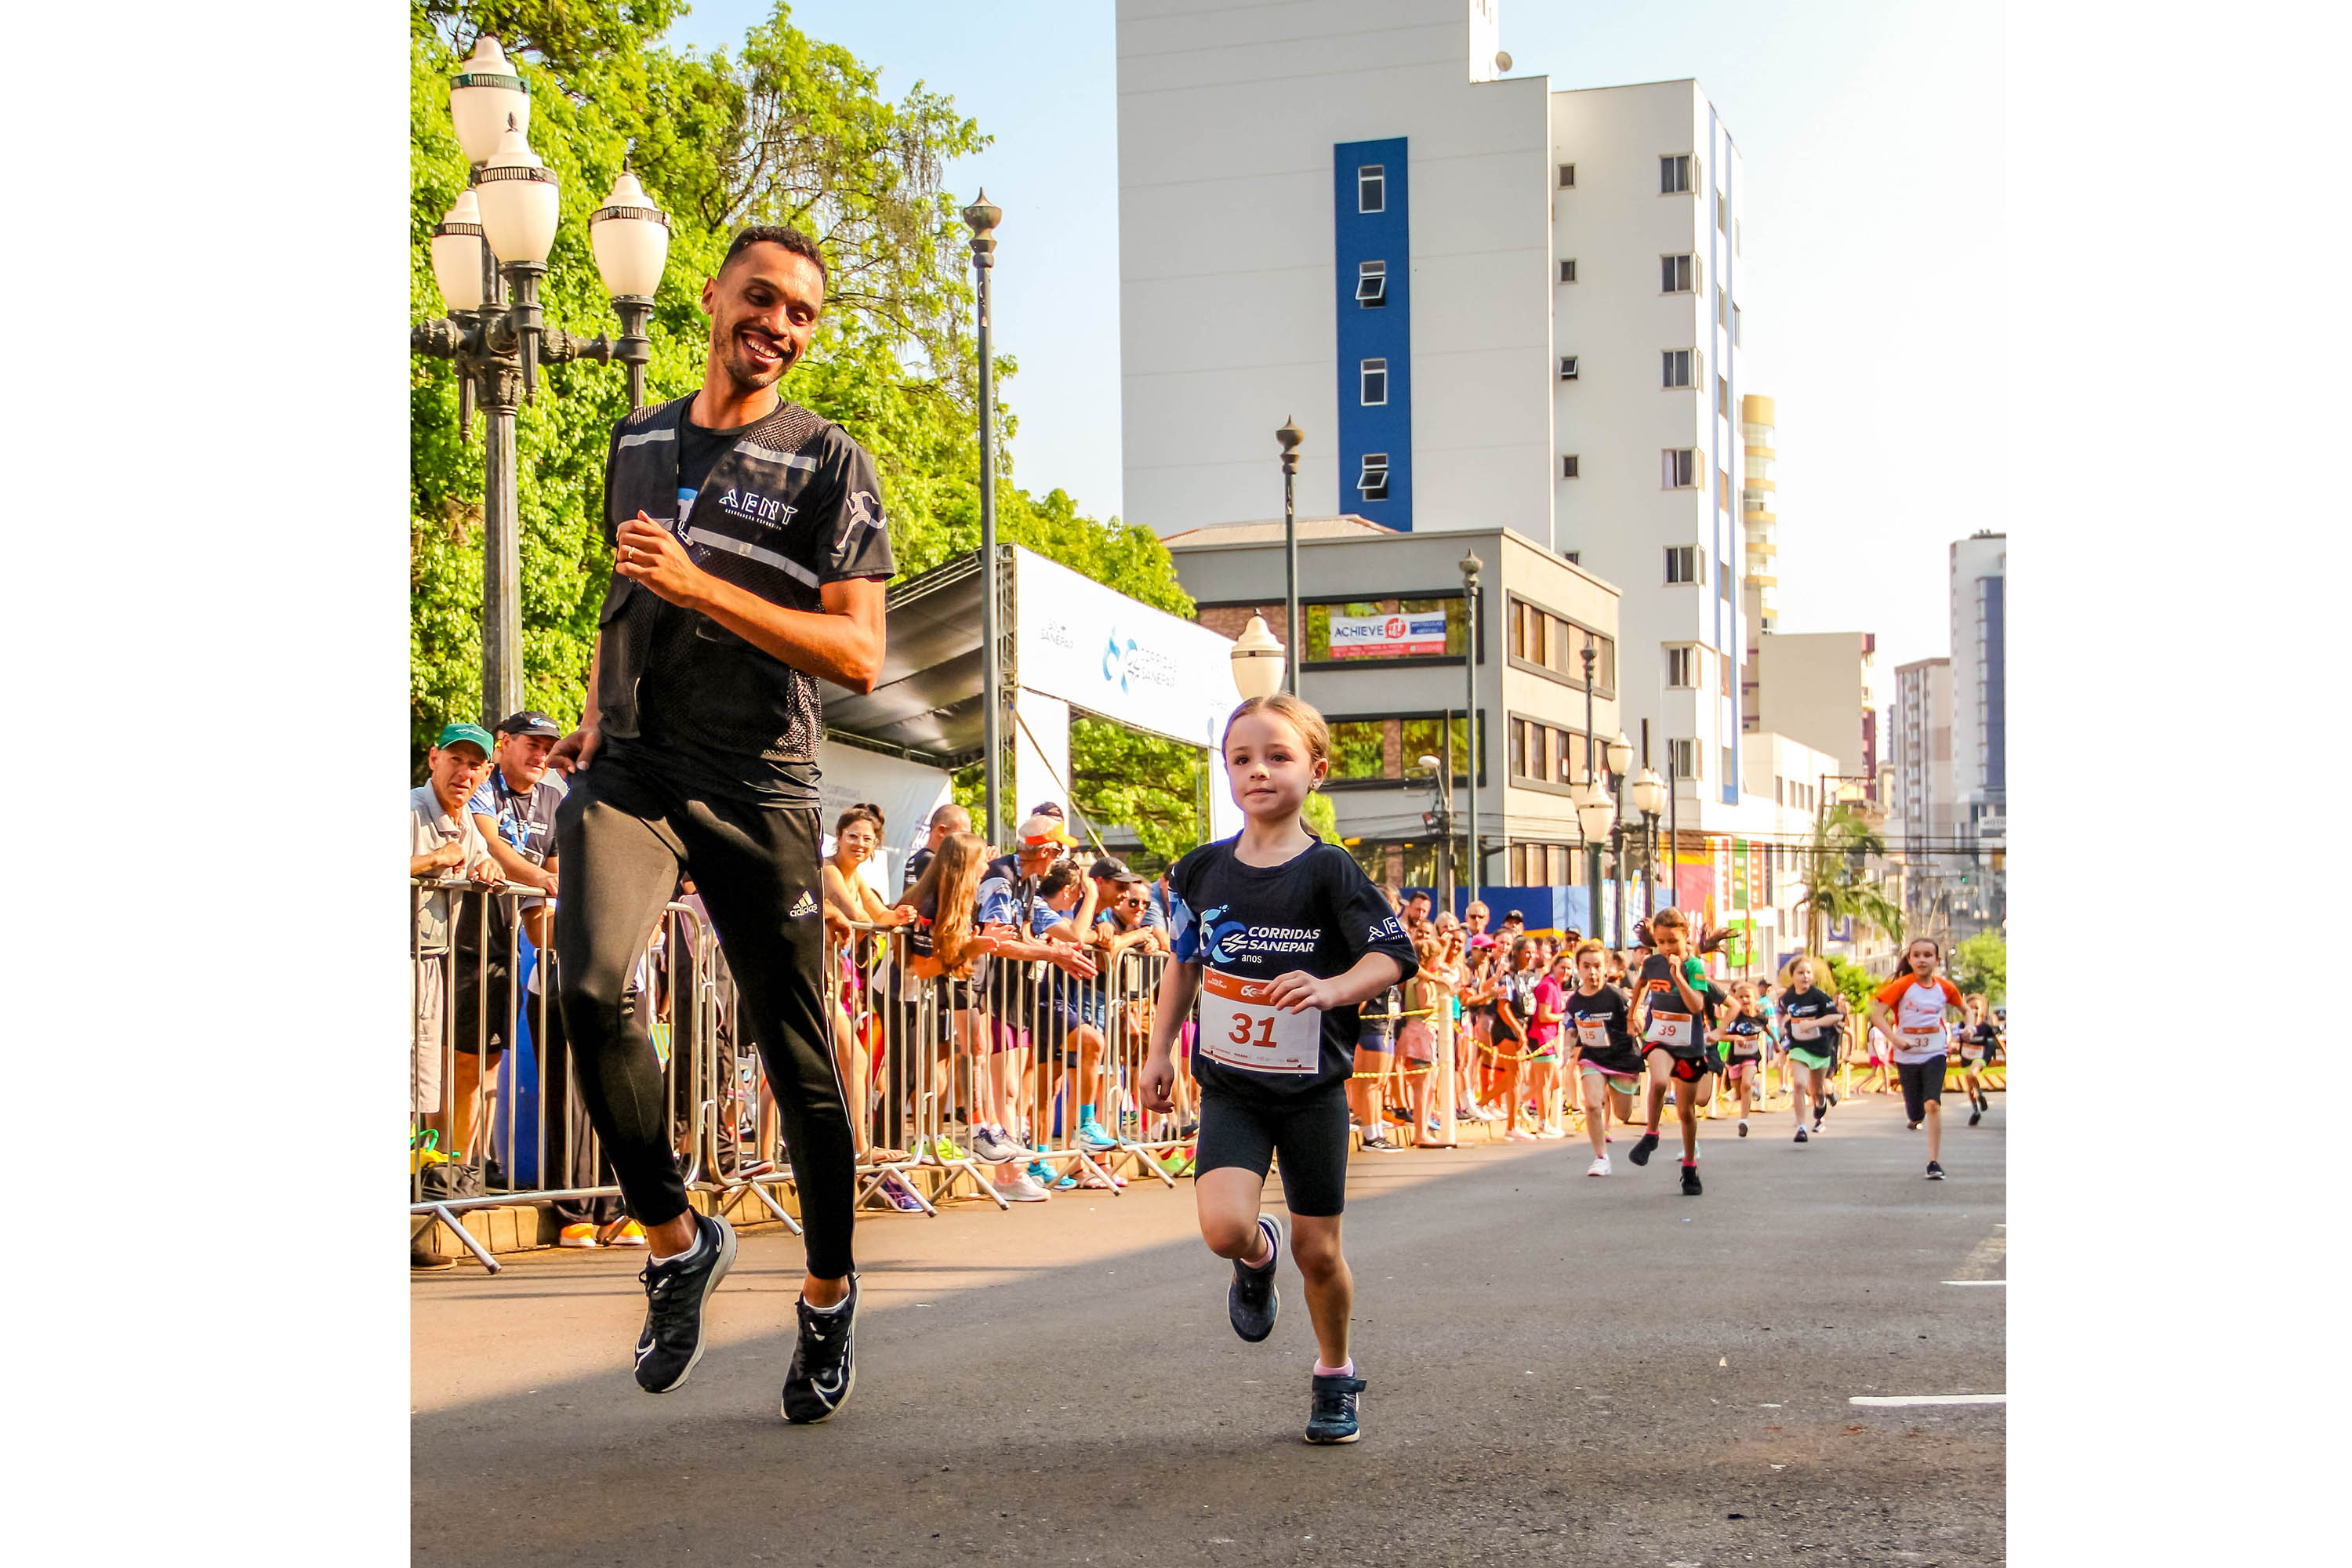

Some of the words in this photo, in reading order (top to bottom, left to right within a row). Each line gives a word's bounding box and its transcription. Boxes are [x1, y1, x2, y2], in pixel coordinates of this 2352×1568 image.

[1334, 625, 1384, 637] ACHIEVE
[789, 903, 818, 917] adidas
[1248, 926, 1321, 939] CORRIDAS
[1248, 940, 1315, 953] SANEPAR
[1241, 954, 1262, 964] anos
[1229, 1013, 1277, 1047] 31
[1658, 1025, 1676, 1036] 39
[1914, 1037, 1929, 1047] 33
